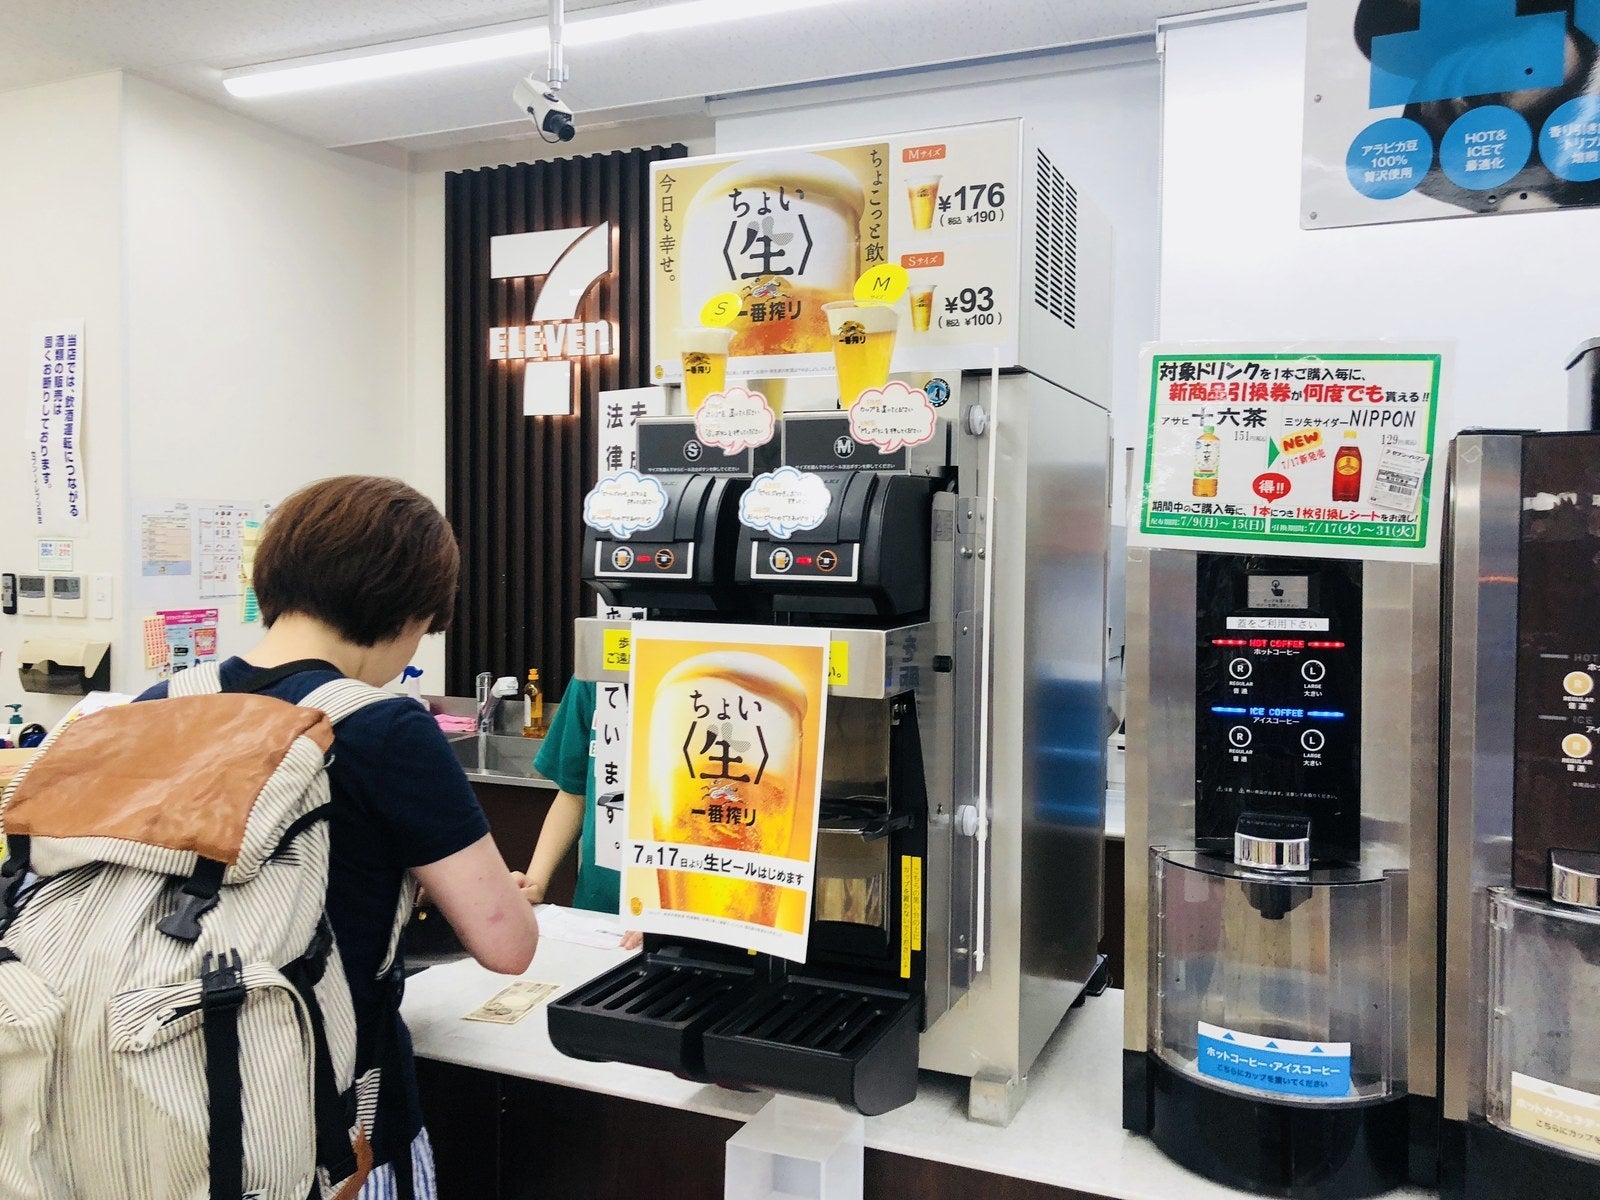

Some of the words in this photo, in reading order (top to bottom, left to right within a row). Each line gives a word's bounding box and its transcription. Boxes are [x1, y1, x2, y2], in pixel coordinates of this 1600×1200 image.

[1464, 129, 1508, 144] HOT&
[908, 148, 942, 161] Mサイズ
[1361, 139, 1419, 156] アラビカ豆
[1466, 143, 1504, 158] ICEで
[1371, 154, 1408, 168] 100%
[727, 186, 804, 218] ちょい
[938, 182, 1005, 213] ¥176
[864, 149, 885, 268] ちょこっと飲
[658, 173, 677, 282] 今日も幸せ。
[873, 277, 891, 291] M
[945, 286, 994, 314] ¥93
[714, 301, 728, 316] S
[839, 336, 866, 345] 一番搾り
[686, 366, 711, 374] 一番搾り
[1159, 362, 1366, 381] 対象ドリンクを1本ご購入毎に、
[606, 403, 623, 472] 法律
[1282, 431, 1319, 451] NEW
[687, 442, 698, 457] S
[837, 439, 852, 455] M
[1281, 448, 1326, 470] 7/17新発売
[1269, 640, 1305, 648] COFFEE
[1253, 648, 1300, 656] ホットコーヒー
[1237, 664, 1244, 673] R
[1309, 666, 1316, 675] L
[689, 689, 762, 720] ちょい
[1249, 707, 1265, 716] ICE
[1268, 708, 1304, 717] COFFEE
[1253, 717, 1300, 725] アイスコーヒー
[1236, 732, 1244, 741] R
[1309, 736, 1316, 745] L
[690, 804, 756, 827] 一番搾り
[633, 844, 804, 886] 7月17日より生ビールはじめます
[1206, 1046, 1341, 1076] ホットコーヒー・アイスコーヒー
